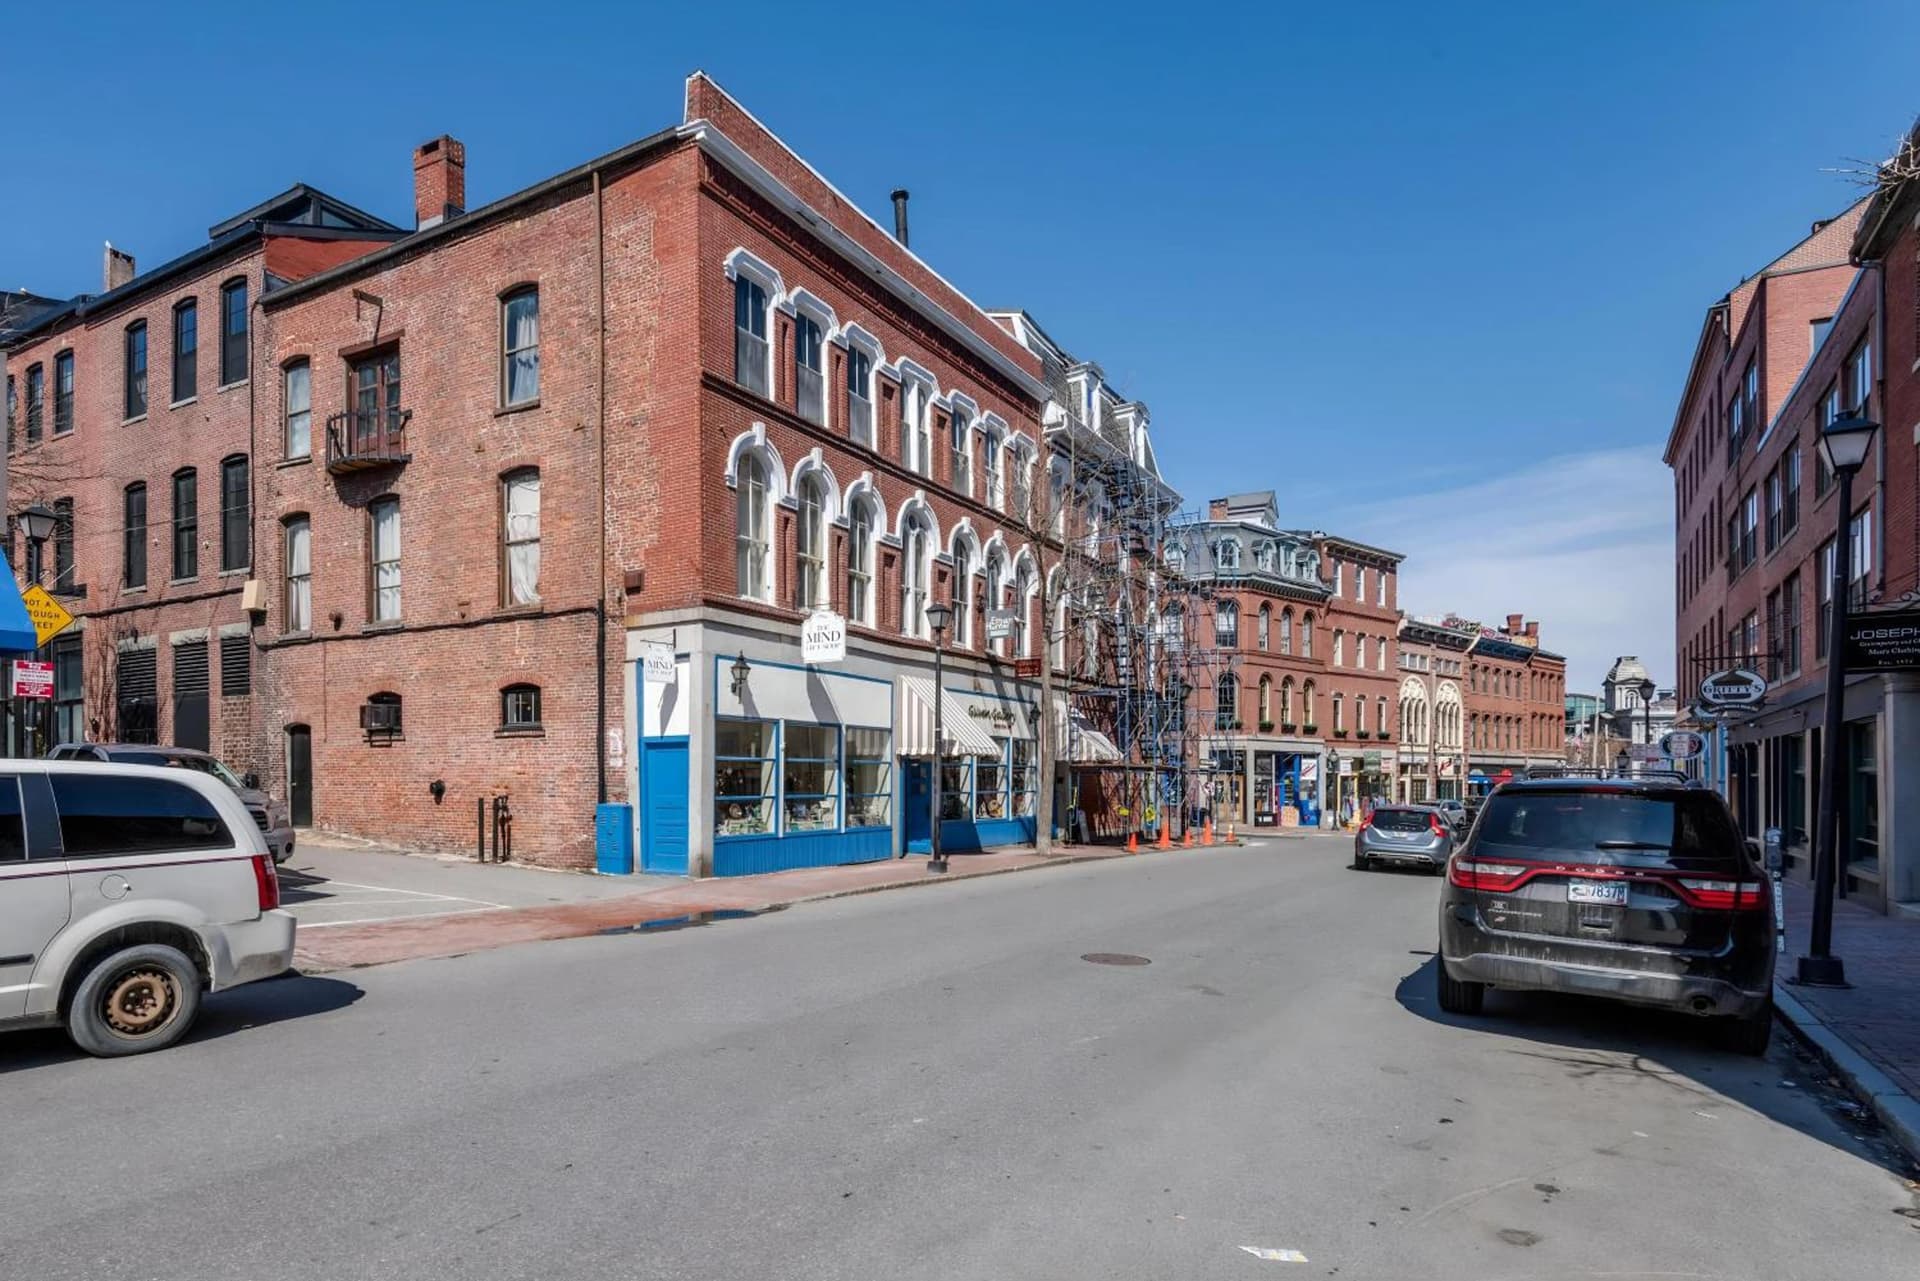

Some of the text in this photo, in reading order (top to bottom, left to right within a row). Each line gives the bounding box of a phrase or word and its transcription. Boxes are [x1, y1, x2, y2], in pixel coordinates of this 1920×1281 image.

[806, 630, 841, 643] MIND
[648, 659, 673, 669] MIND
[1703, 683, 1762, 694] GRITTY'S
